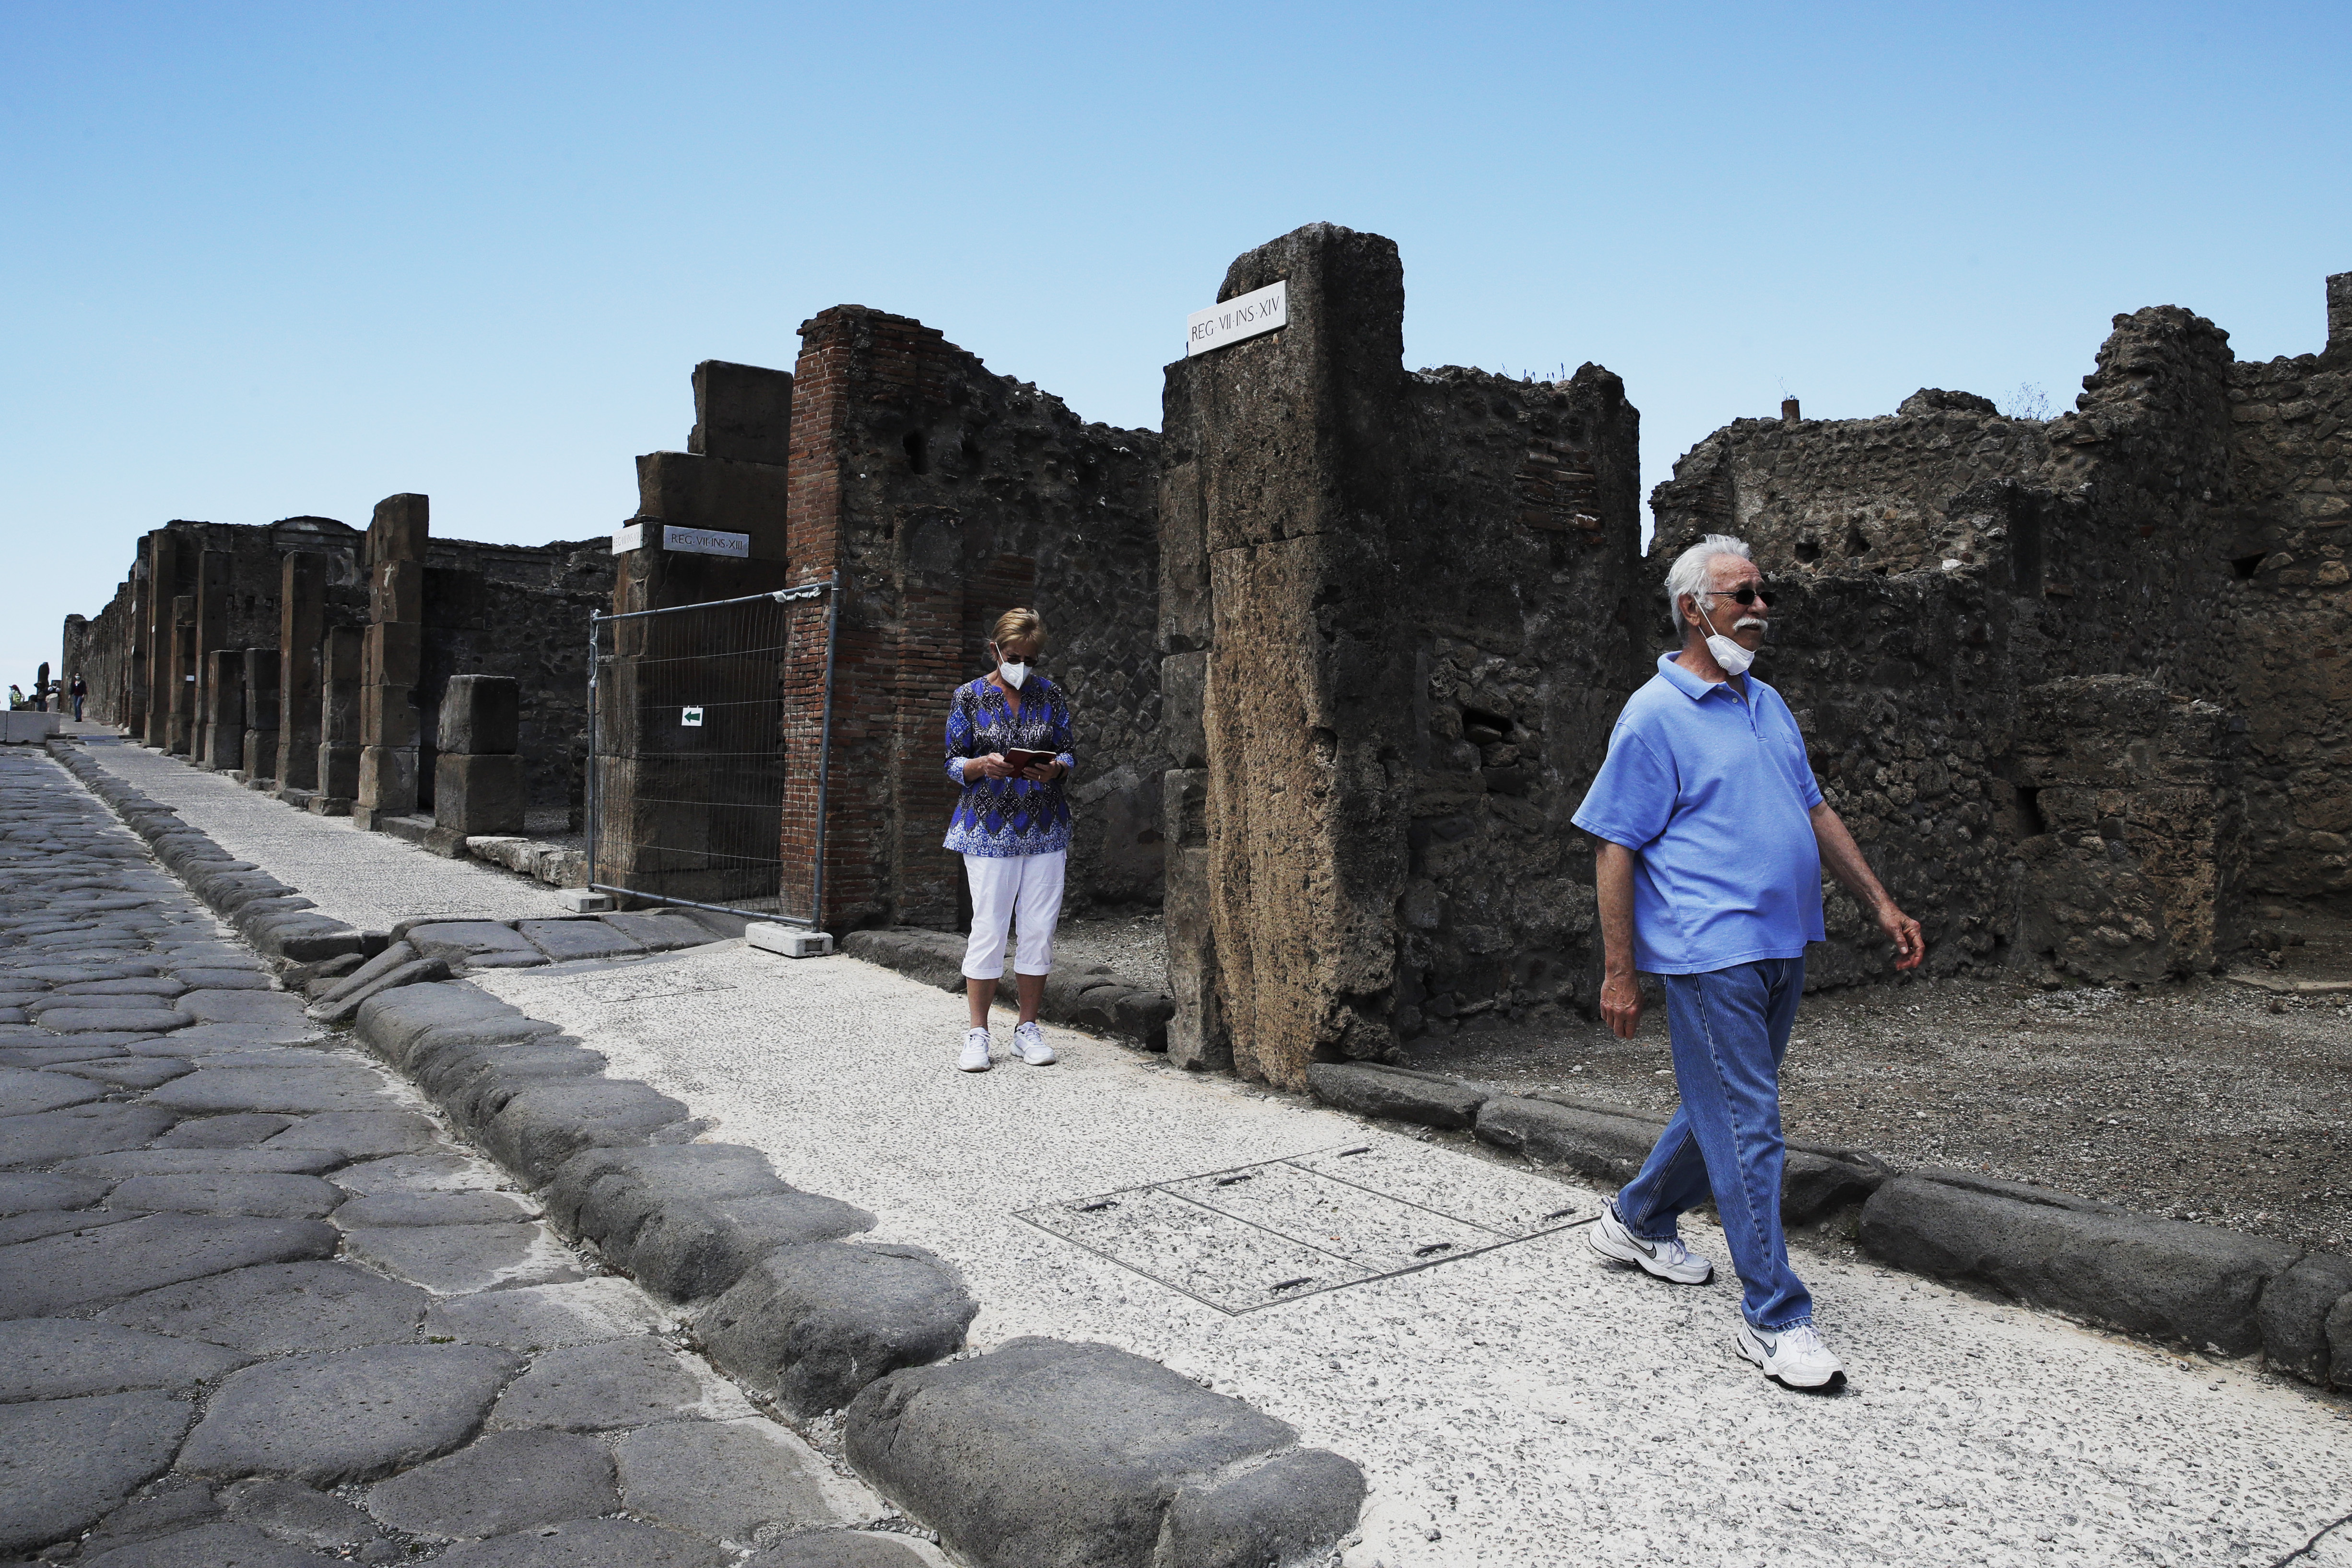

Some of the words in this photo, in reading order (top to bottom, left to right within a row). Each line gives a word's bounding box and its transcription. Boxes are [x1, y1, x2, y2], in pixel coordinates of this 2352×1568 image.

[1192, 320, 1213, 342] REG
[1219, 313, 1231, 331] VII
[1236, 305, 1254, 327] INS
[1259, 296, 1280, 318] XIV
[696, 536, 708, 546] VII
[729, 539, 742, 550] XIII
